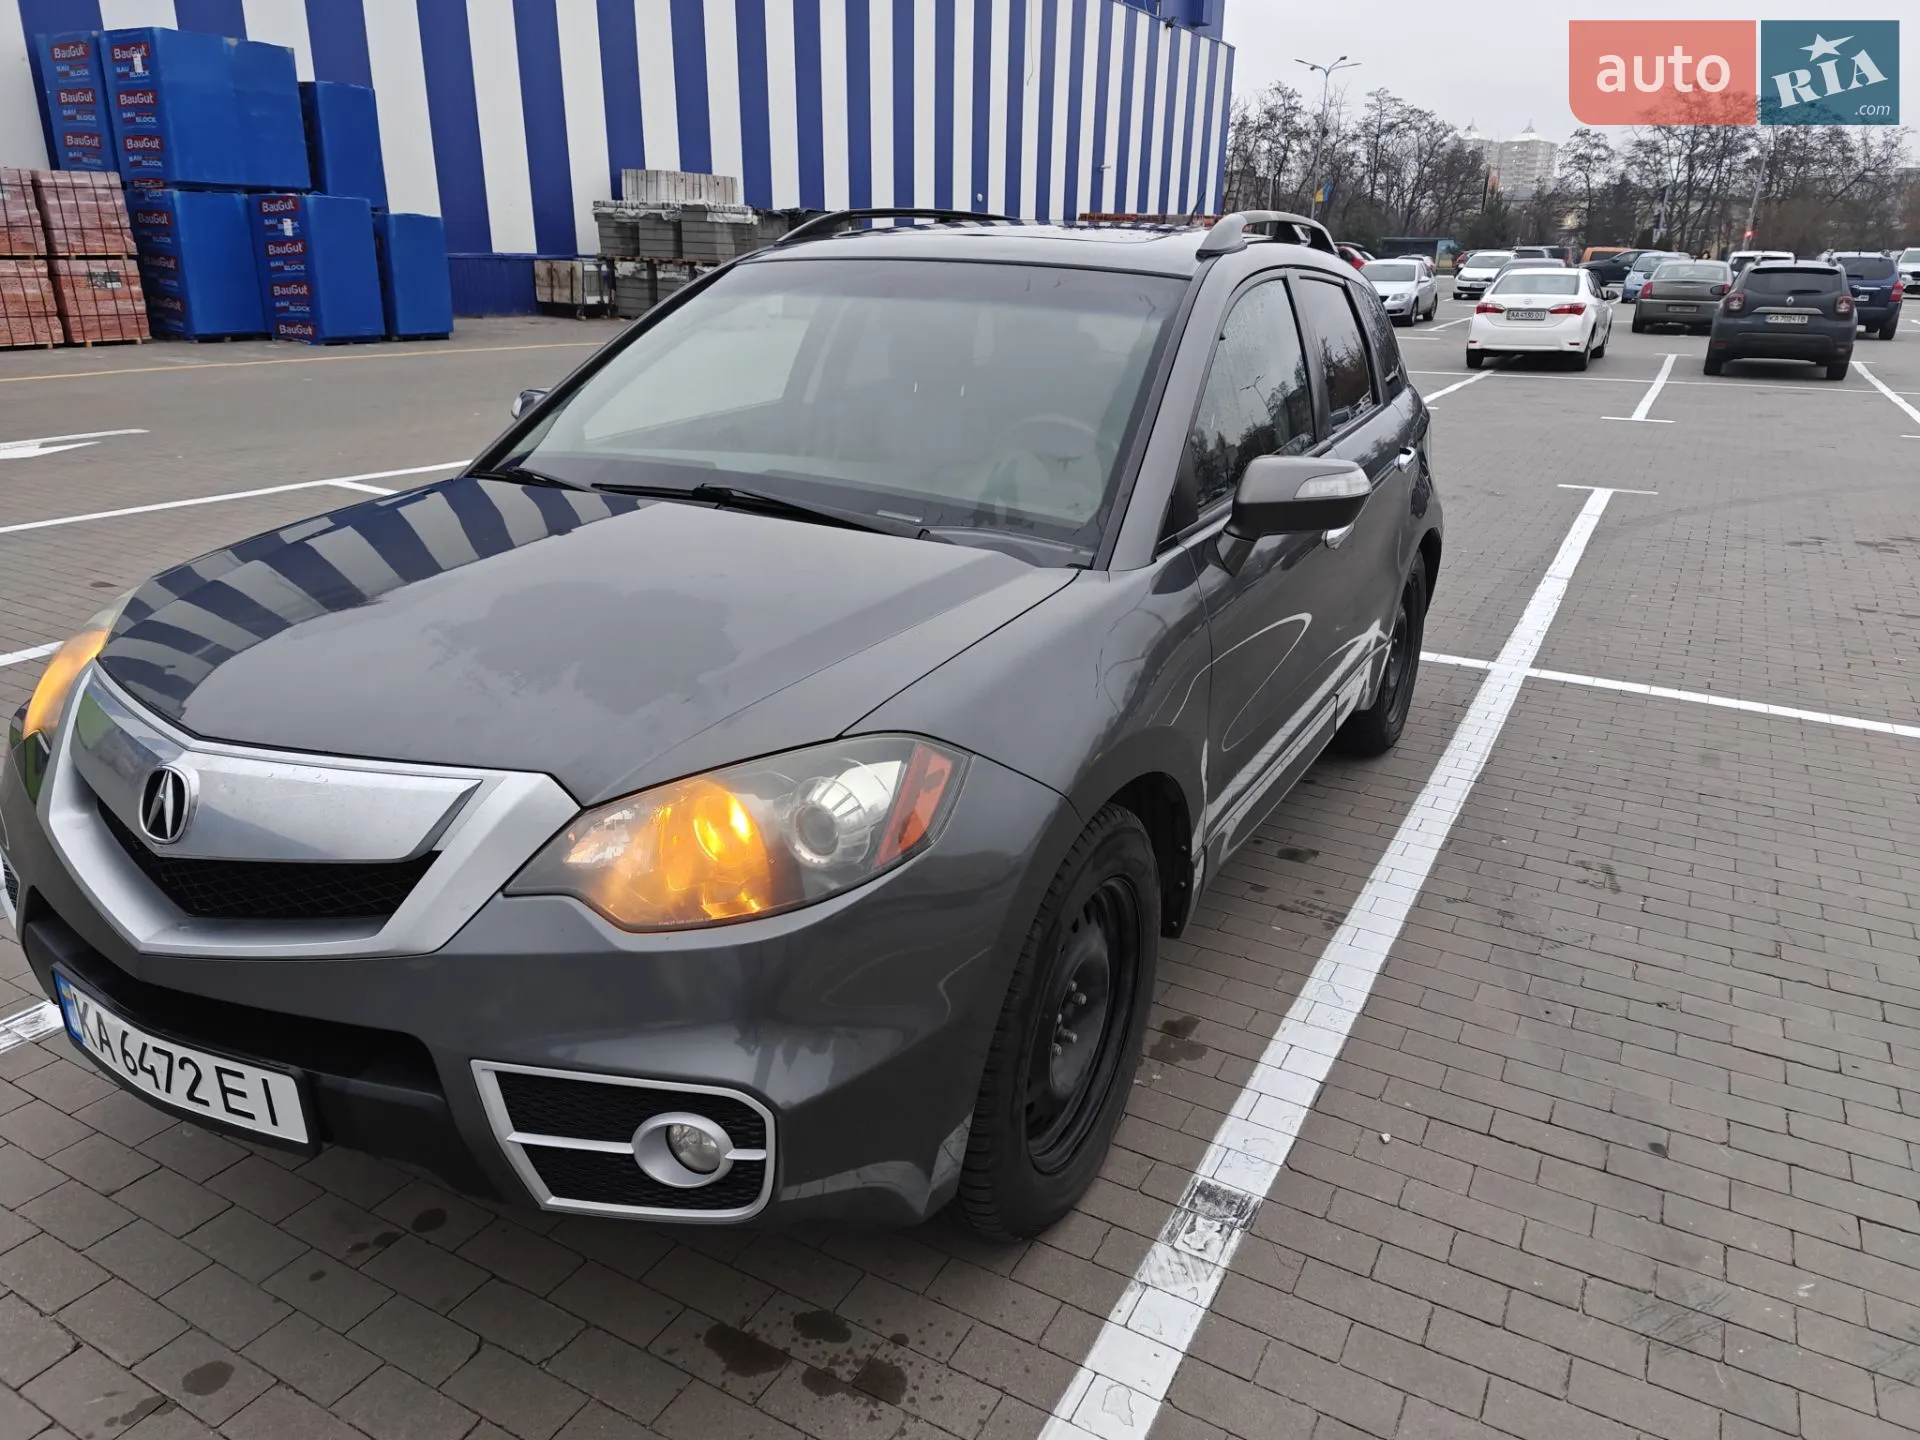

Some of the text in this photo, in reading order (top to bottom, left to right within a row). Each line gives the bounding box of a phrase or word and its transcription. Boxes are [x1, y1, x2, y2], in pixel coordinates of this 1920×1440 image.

[54, 44, 85, 59] BauGut
[114, 45, 147, 60] BauGut
[60, 90, 93, 103] BauGut
[120, 93, 154, 105] BauGut
[66, 135, 100, 147] BauGut
[126, 138, 160, 149] BauGut
[262, 199, 296, 212] BauGut
[138, 212, 169, 225] BauGut
[268, 242, 304, 255] BauGut
[273, 284, 309, 296] BauGut
[279, 324, 313, 336] BauGut
